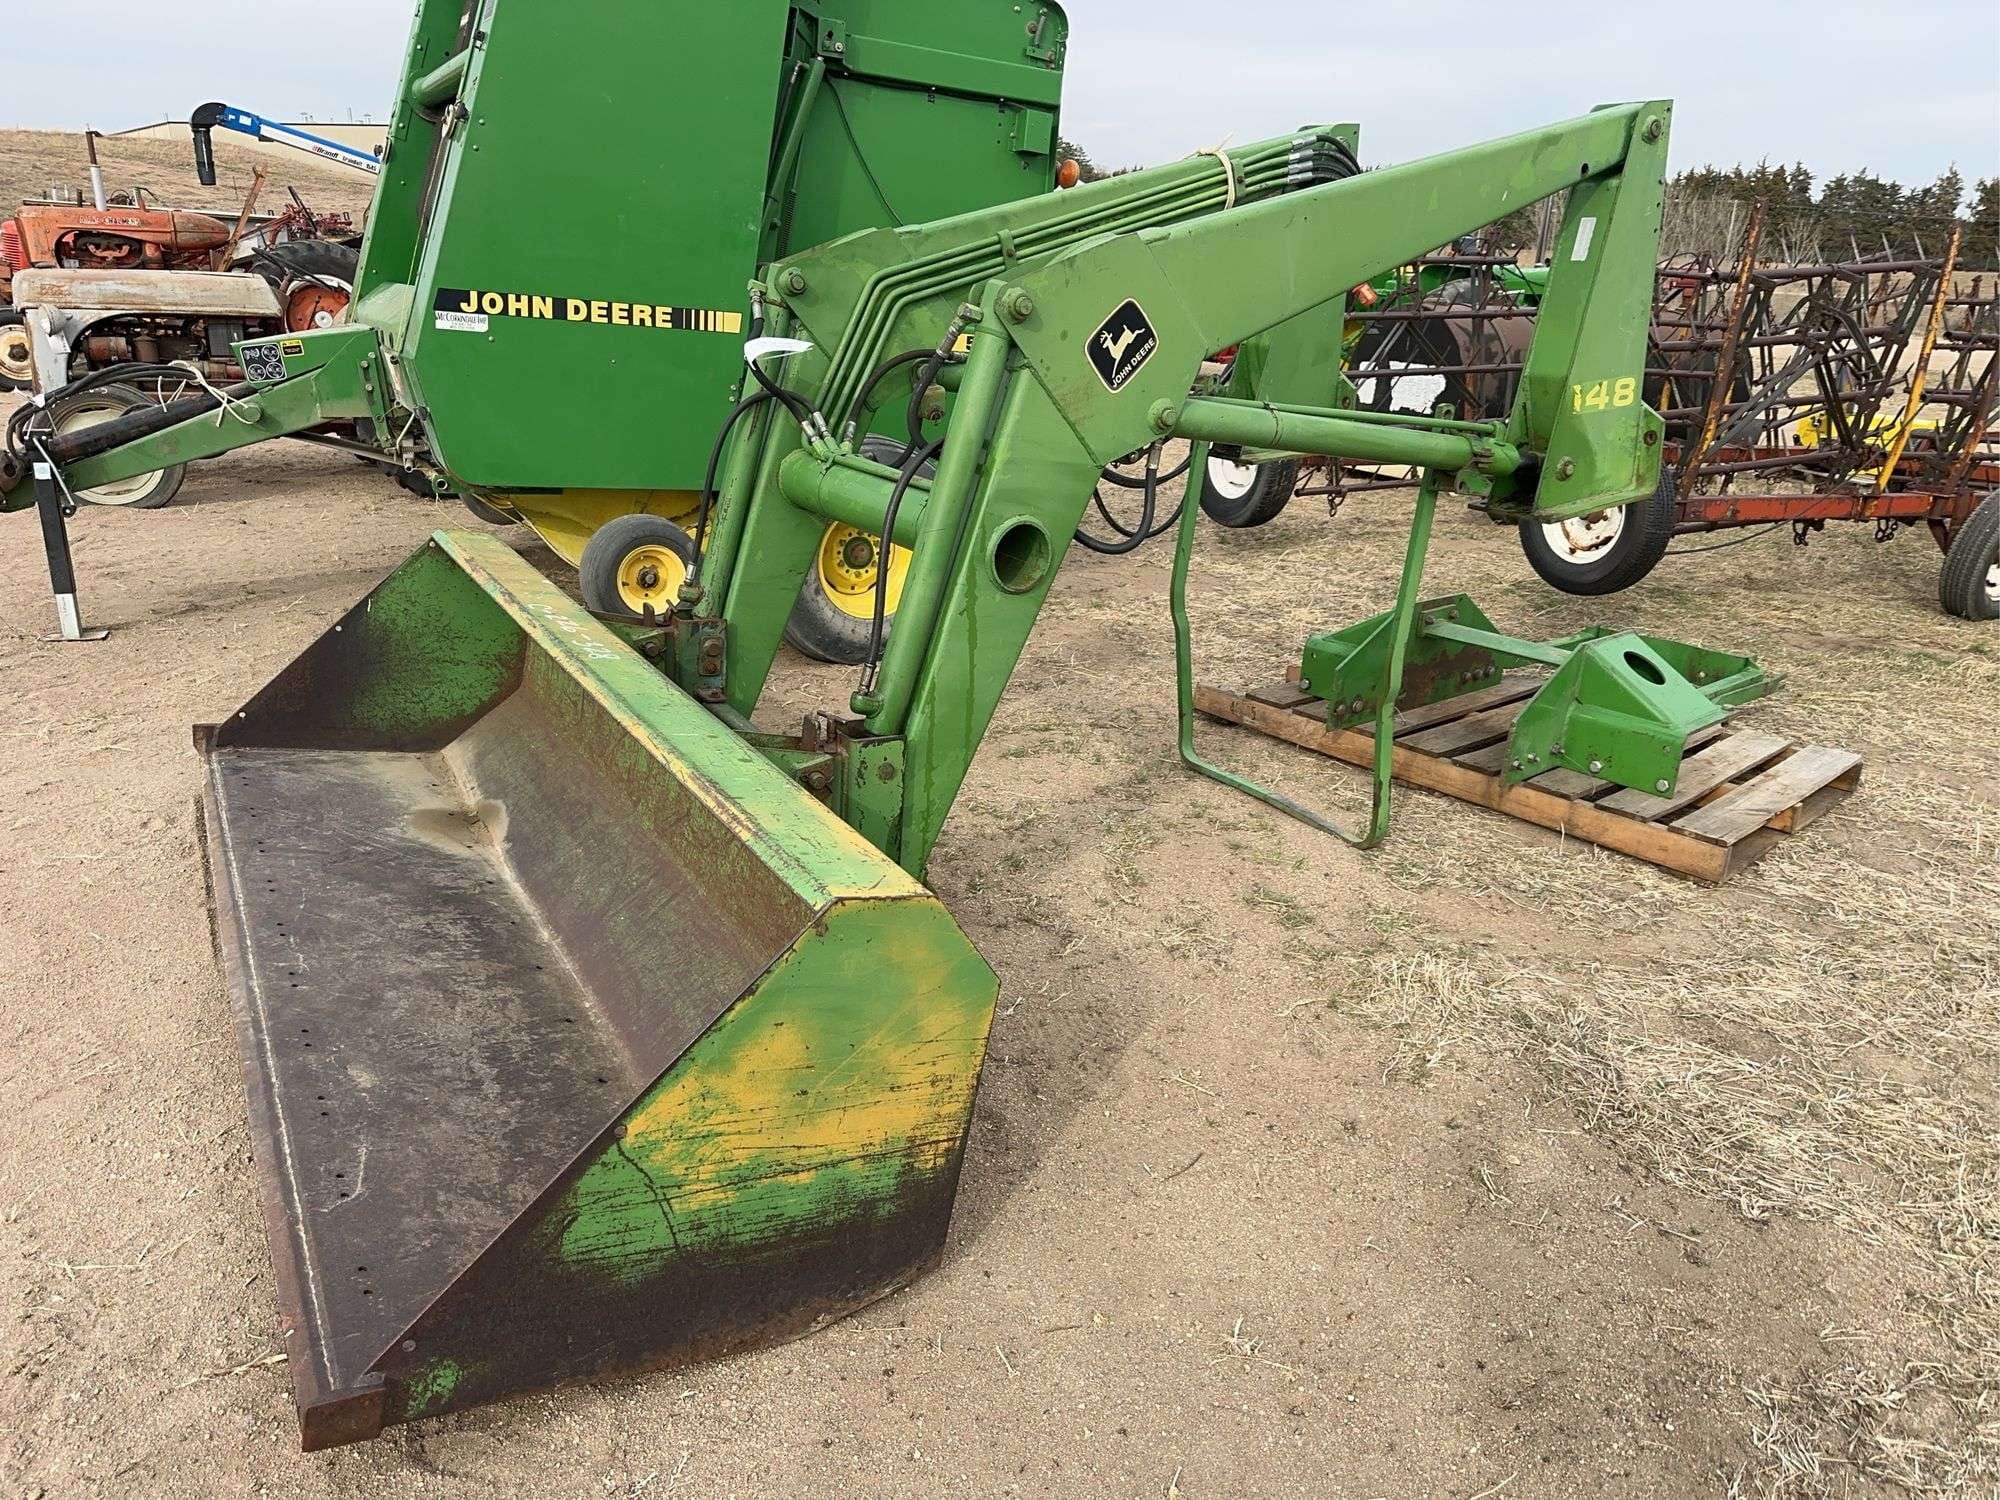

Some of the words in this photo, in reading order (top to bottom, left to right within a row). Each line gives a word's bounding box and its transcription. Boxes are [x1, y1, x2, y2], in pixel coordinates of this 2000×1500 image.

[460, 290, 553, 319] JOHN
[566, 298, 673, 329] DEERE
[1112, 363, 1133, 388] JOHN
[1130, 337, 1156, 367] DEERE
[1573, 377, 1636, 414] 148
